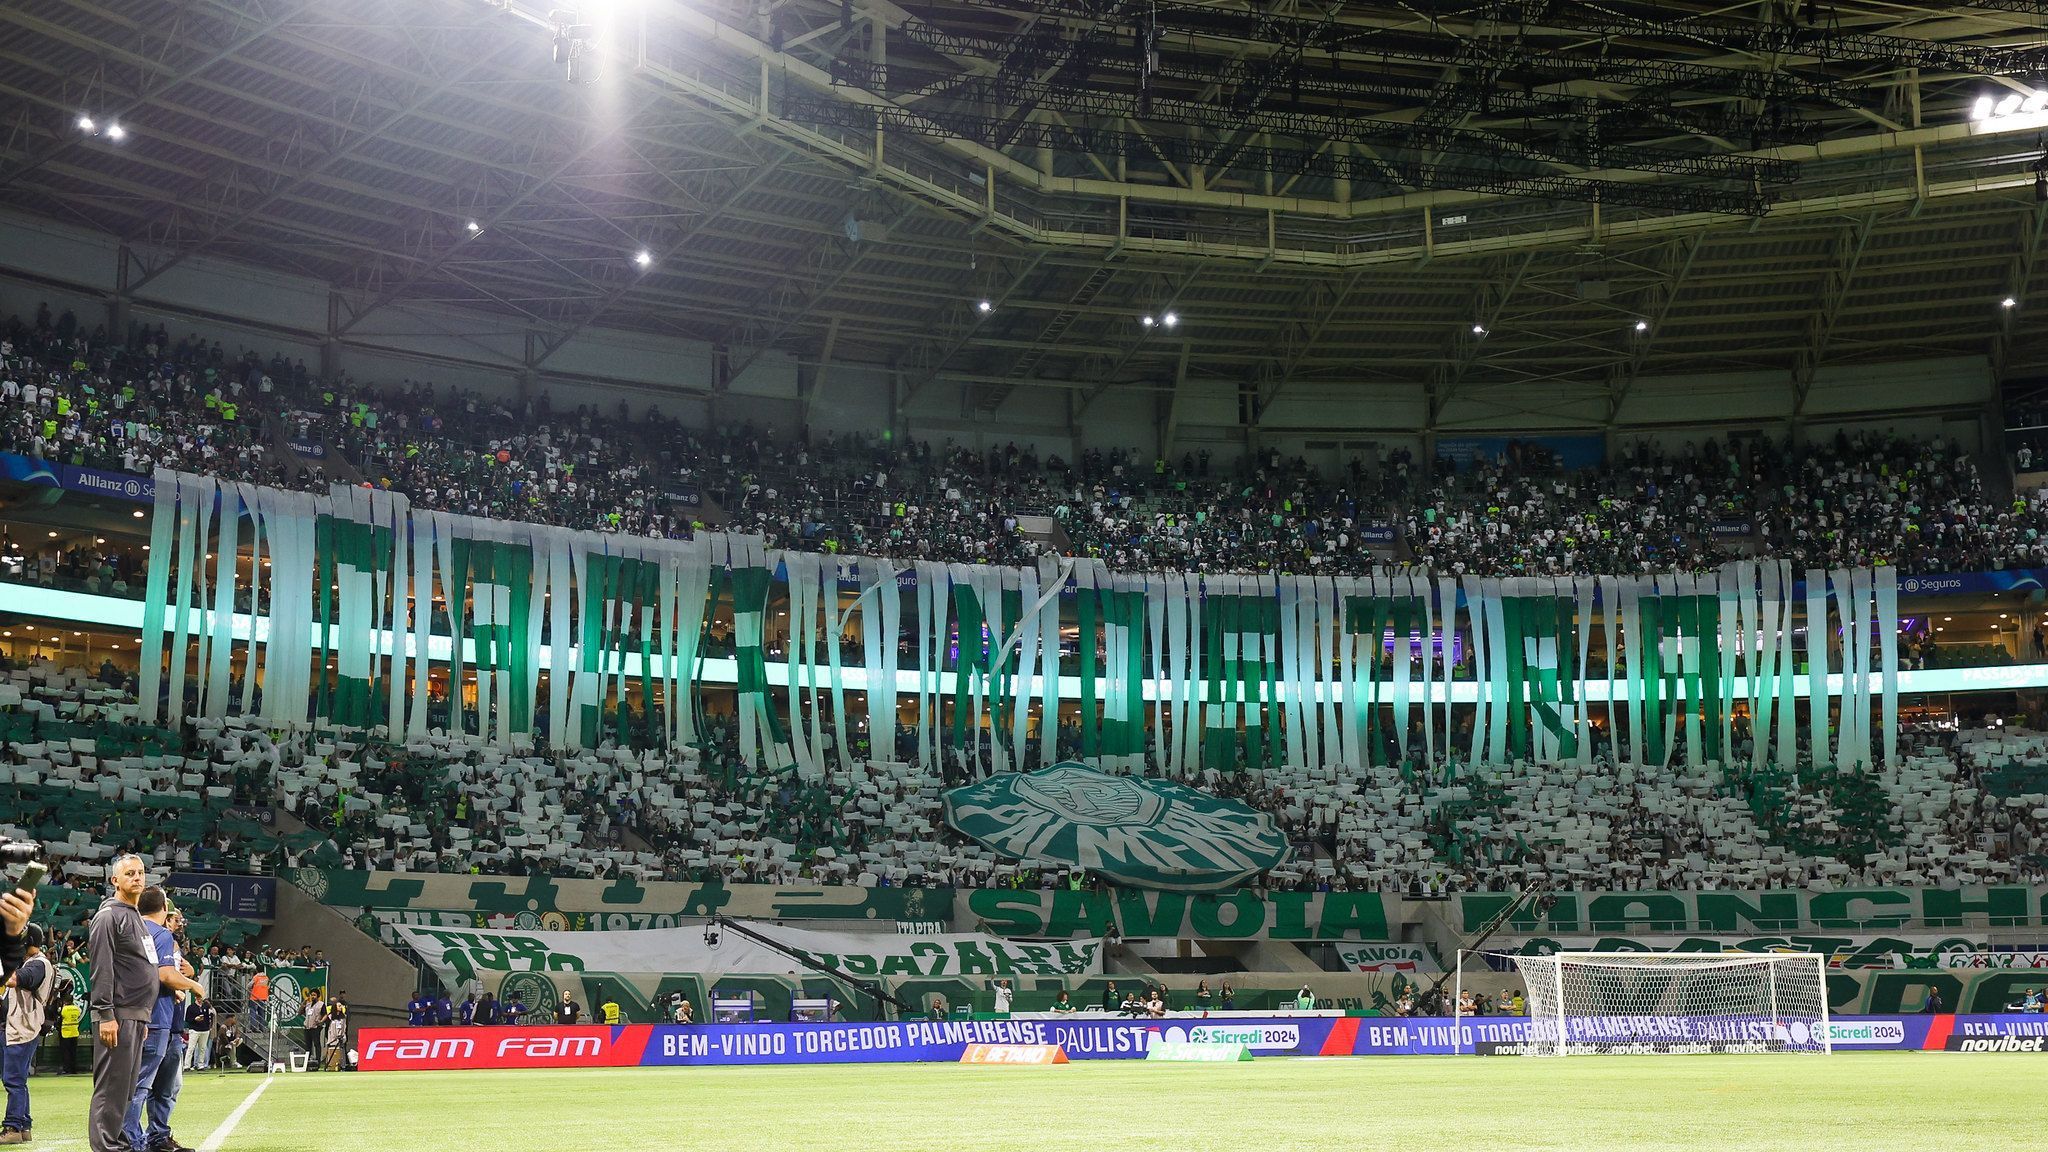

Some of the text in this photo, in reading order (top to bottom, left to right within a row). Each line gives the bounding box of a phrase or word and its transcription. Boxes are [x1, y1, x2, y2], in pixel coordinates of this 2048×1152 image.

[78, 473, 122, 491] Allianz
[1920, 577, 1961, 590] Seguros
[1460, 888, 2048, 932] MANCH
[896, 921, 943, 935] ITAPIRA
[663, 1032, 786, 1056] BEM-VINDO
[793, 1025, 901, 1053] TORCEDOR
[907, 1020, 1049, 1046] PALMEIRENSE
[1211, 1030, 1297, 1044] Sicredi 2024
[1369, 1026, 1473, 1047] BEM-VINDO
[1829, 1025, 1902, 1039] Sicredi 2024
[1960, 1035, 2044, 1052] novibet
